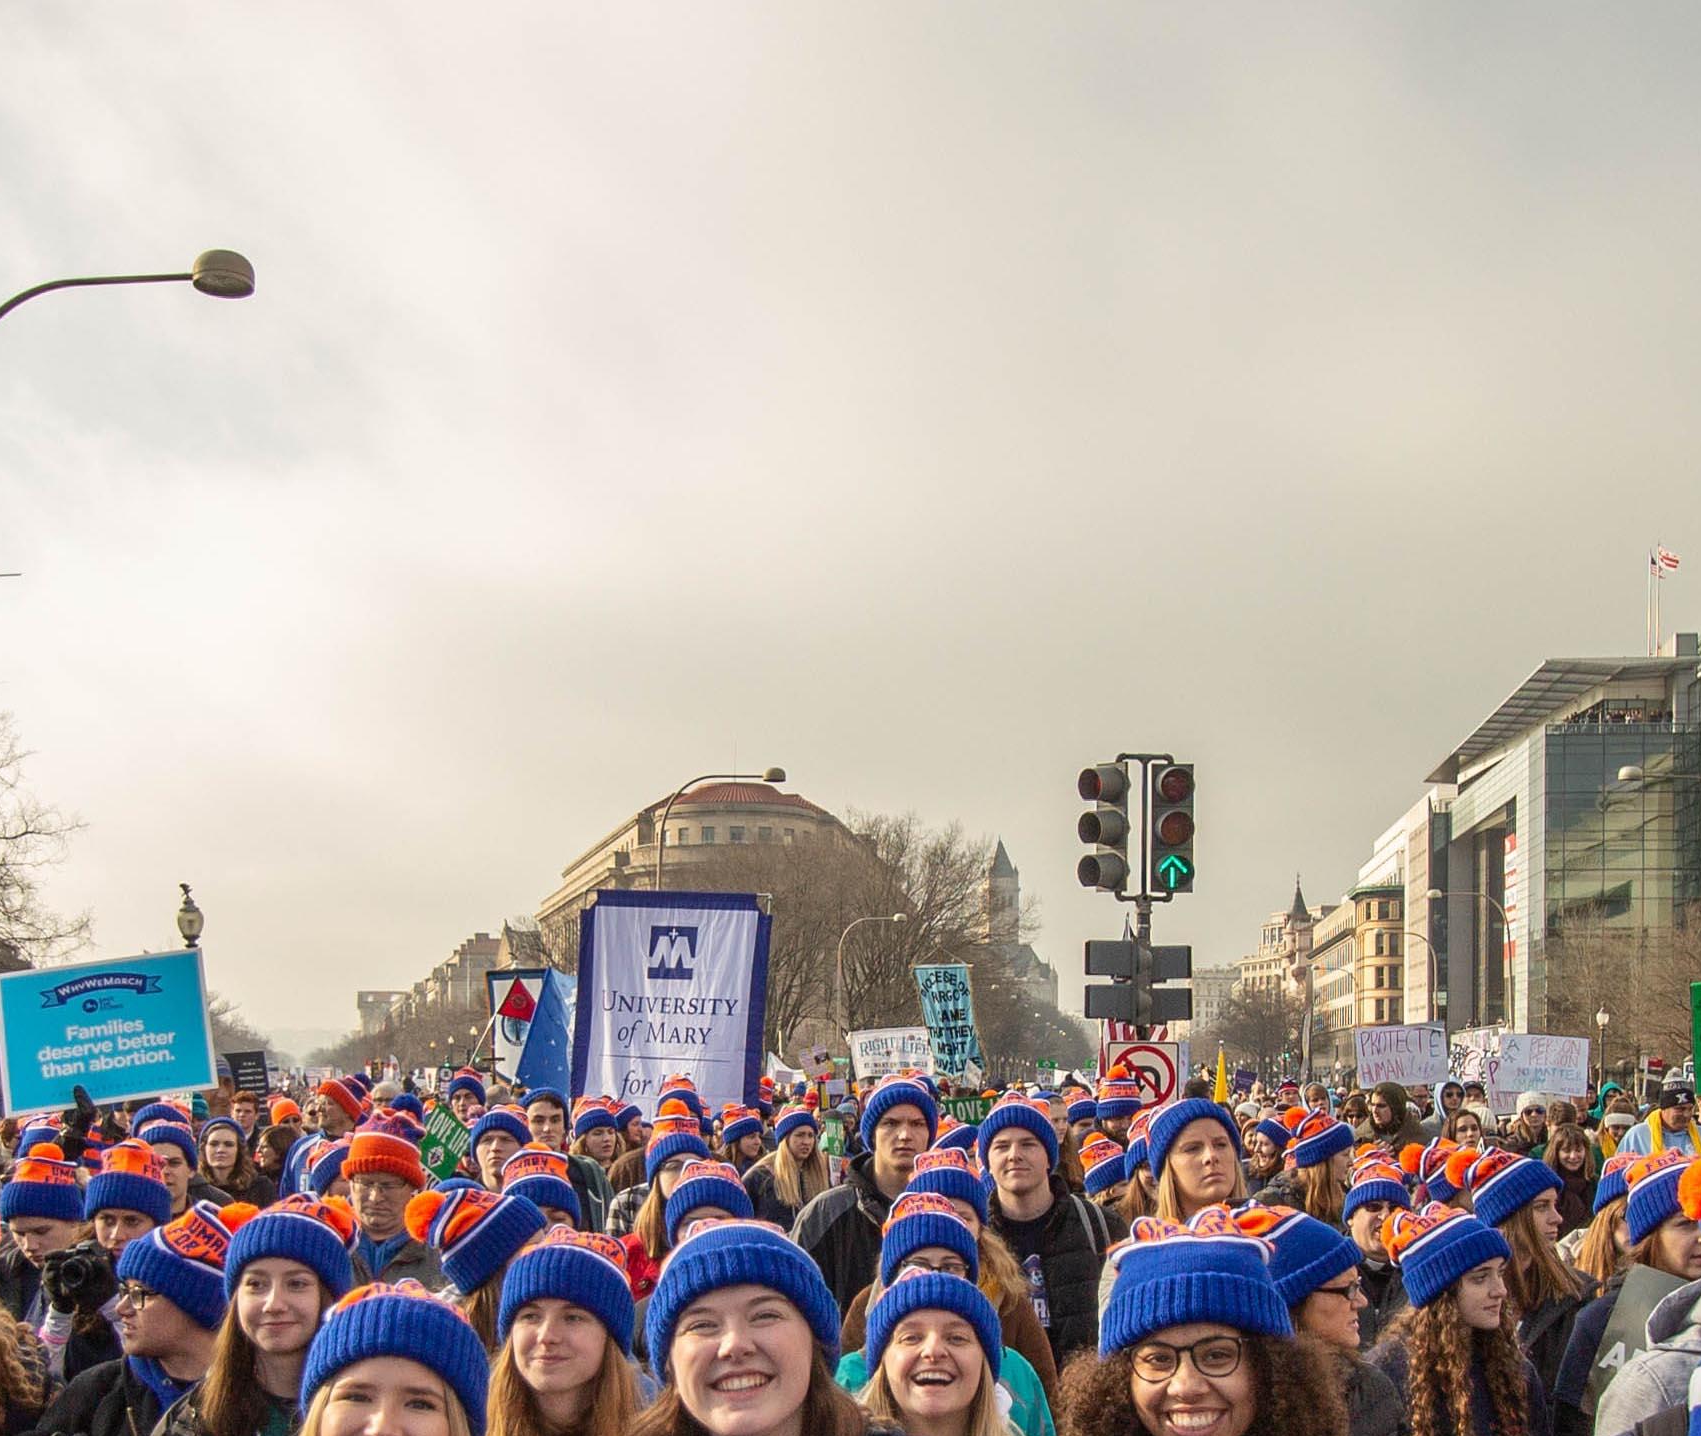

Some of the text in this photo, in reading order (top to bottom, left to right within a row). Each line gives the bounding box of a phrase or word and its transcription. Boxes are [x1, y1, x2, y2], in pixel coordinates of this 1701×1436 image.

[601, 989, 739, 1017] UNIVERSITY
[65, 1018, 145, 1043] Families
[617, 1019, 712, 1048] of MARY
[37, 1030, 176, 1063] deserve better
[41, 1048, 176, 1080] than abortion.
[620, 1069, 651, 1100] for
